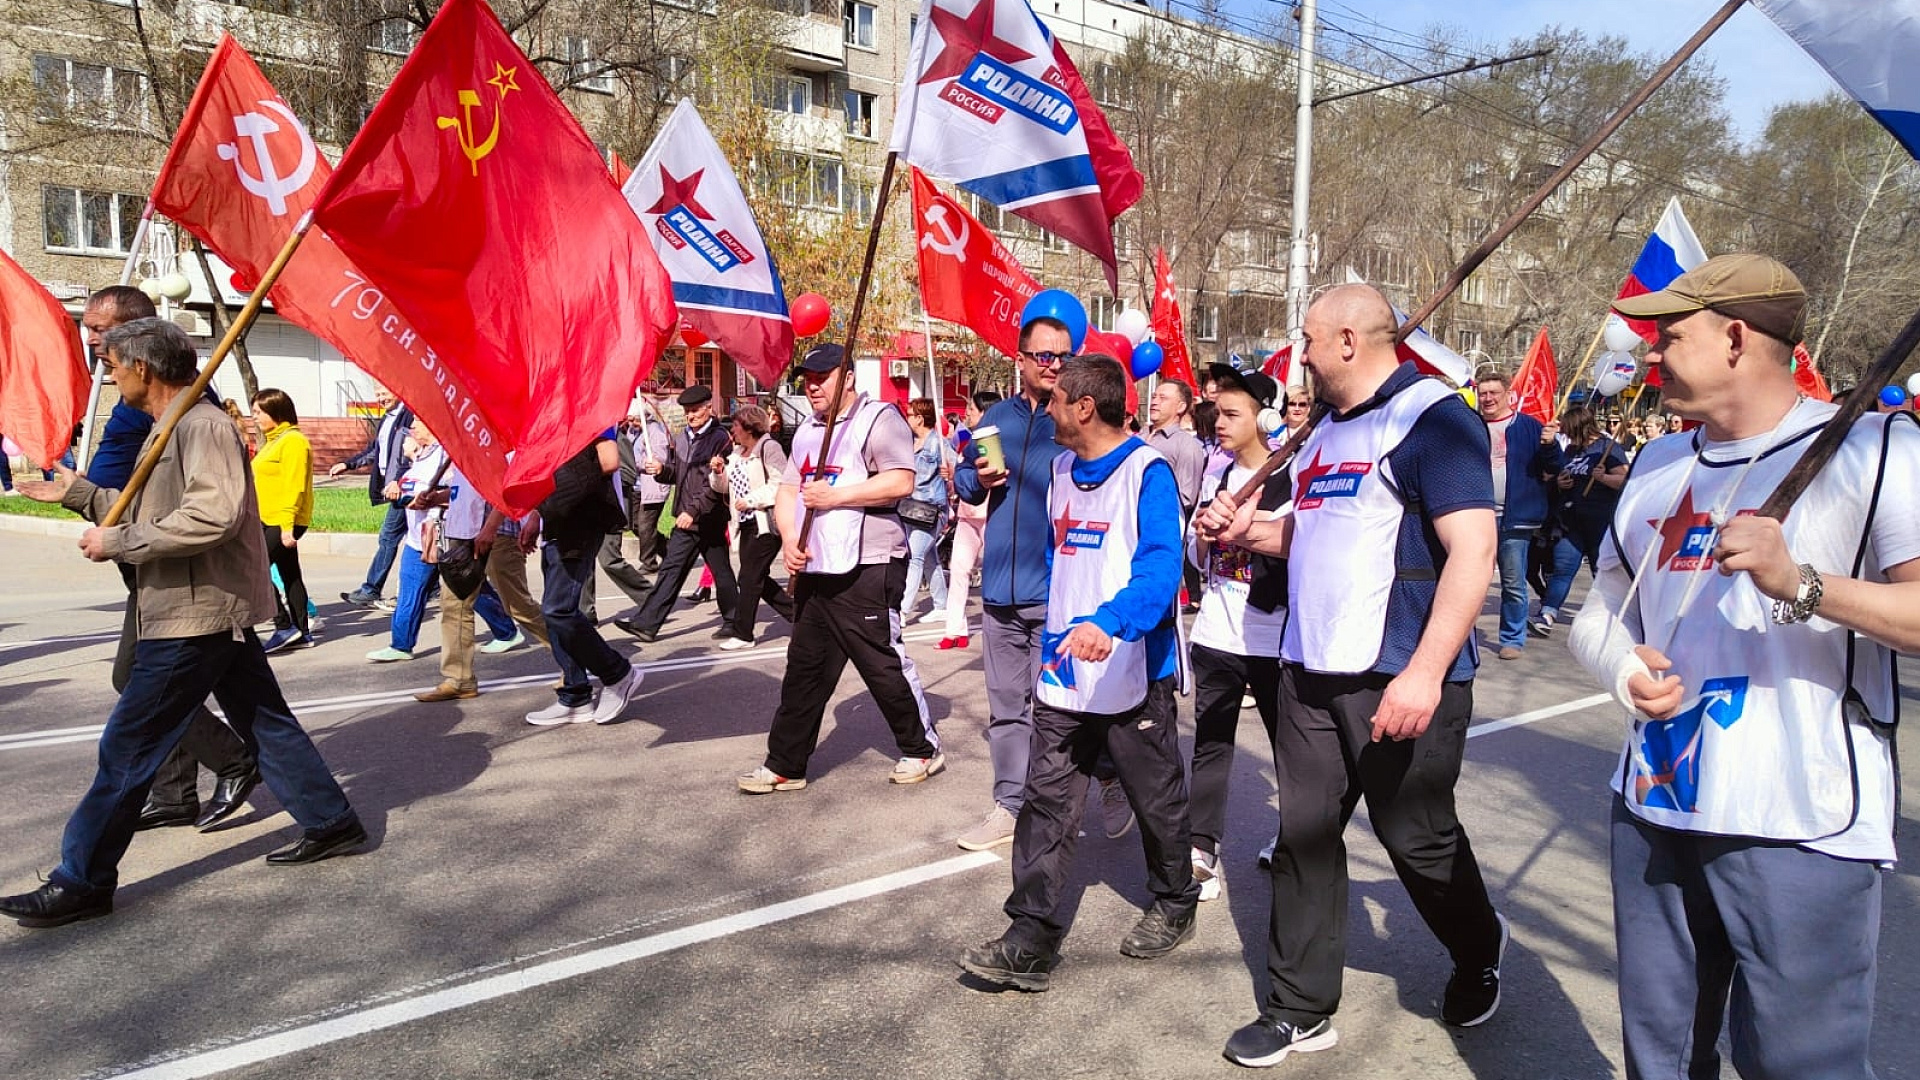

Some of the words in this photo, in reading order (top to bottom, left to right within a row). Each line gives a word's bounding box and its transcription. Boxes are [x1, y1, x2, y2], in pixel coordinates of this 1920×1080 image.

[948, 88, 996, 118] РОССИЯ
[970, 63, 1073, 126] РОДИНА
[670, 211, 731, 267] РОДИНА
[721, 232, 751, 260] ПАРТИЯ
[330, 269, 385, 320] 79
[990, 289, 1011, 322] 79
[1308, 478, 1356, 494] РОДИНА
[1066, 532, 1101, 546] РОДИНА
